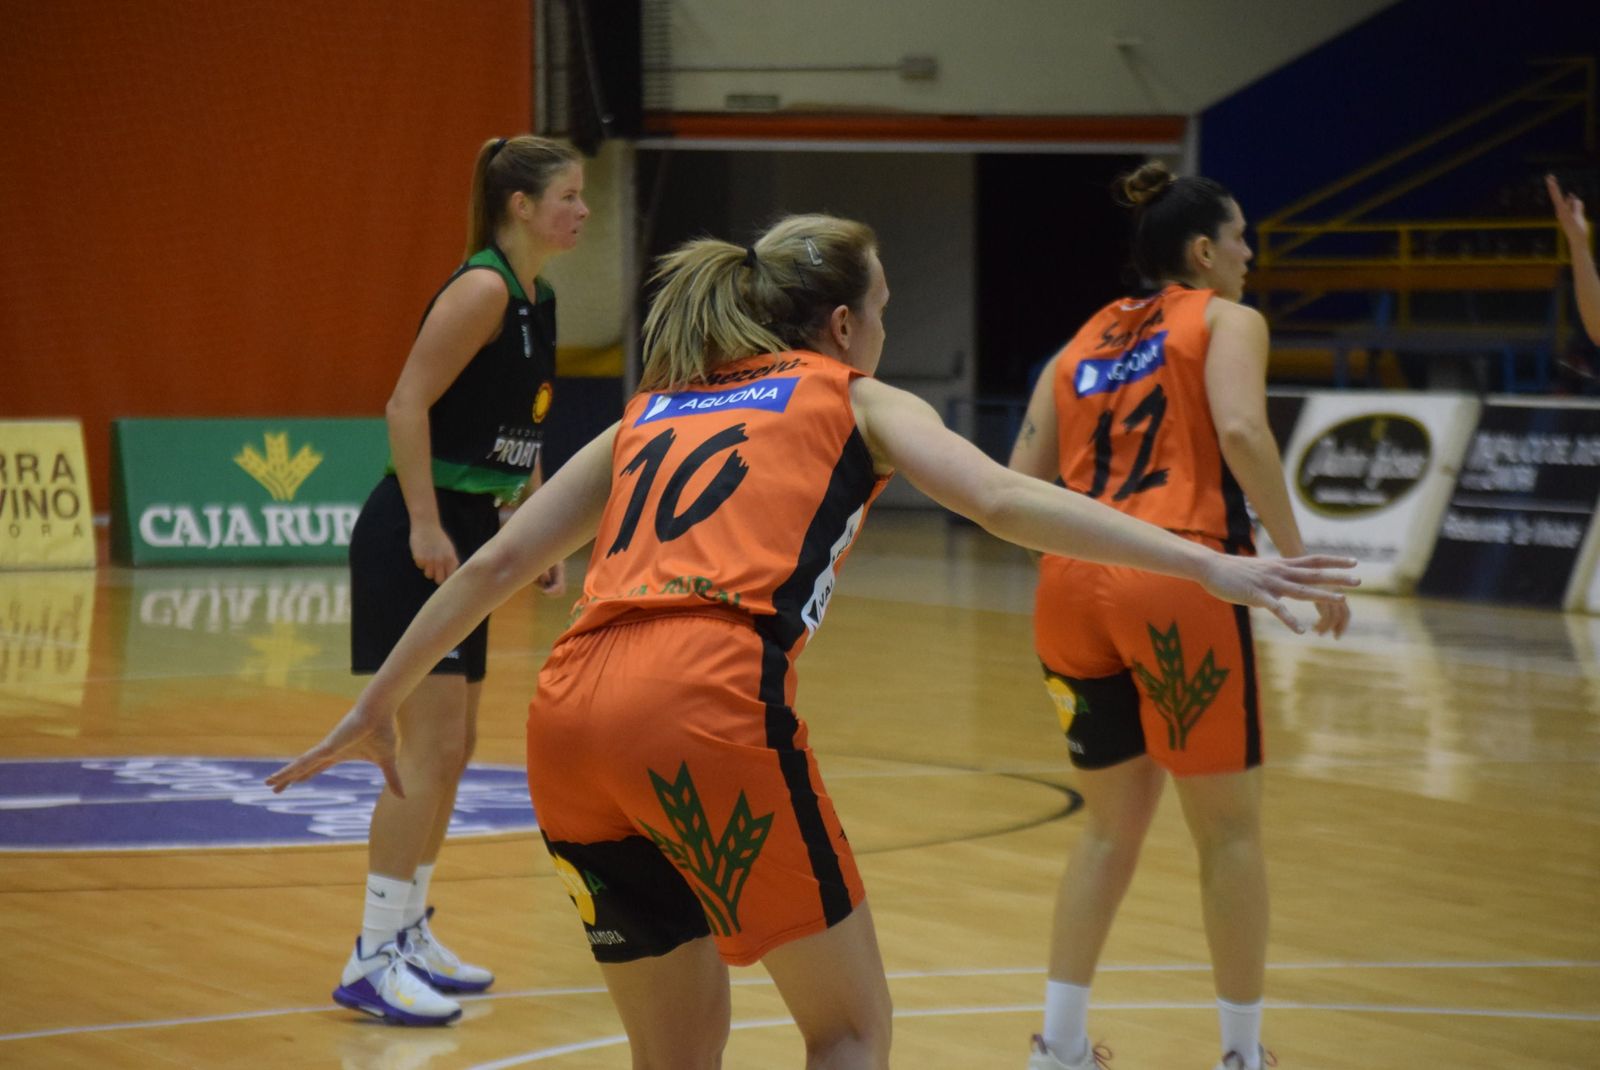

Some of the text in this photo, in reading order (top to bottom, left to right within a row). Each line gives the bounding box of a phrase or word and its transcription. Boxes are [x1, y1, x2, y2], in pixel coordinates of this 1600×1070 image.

[678, 386, 779, 410] AQUONA
[1087, 384, 1169, 501] 12
[139, 504, 261, 548] CAJA
[606, 422, 750, 559] 10
